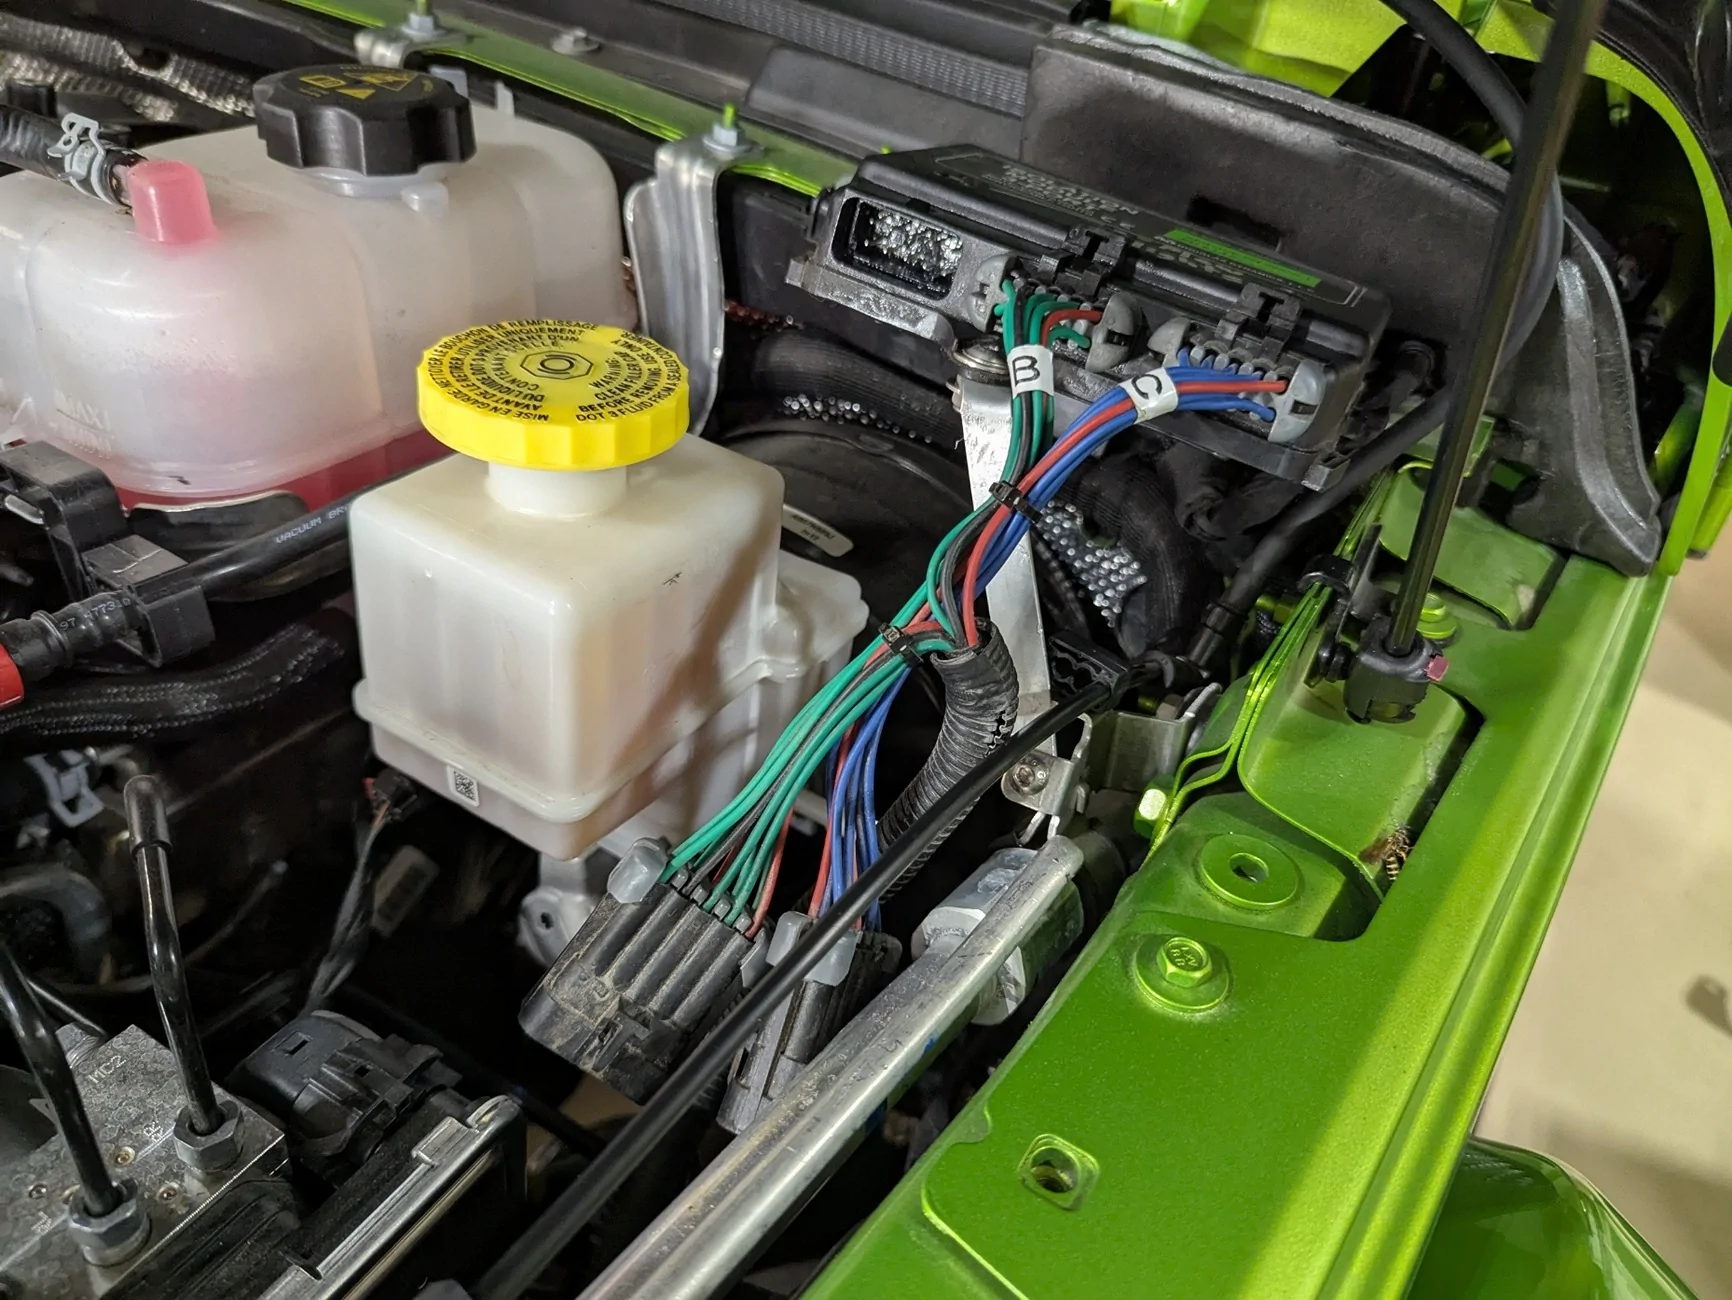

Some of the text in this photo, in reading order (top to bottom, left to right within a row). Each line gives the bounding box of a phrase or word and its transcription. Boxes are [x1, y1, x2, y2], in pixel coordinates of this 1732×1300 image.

[497, 327, 586, 339] UNIQUEMENT
[547, 334, 580, 342] D'UN
[611, 339, 642, 352] ONLY
[637, 353, 658, 364] USE
[428, 319, 600, 421] MISE EN GARDE: NETTOYER LE BOUCHON DE REMPLISSAGE
[589, 357, 621, 388] WARNING:
[594, 350, 643, 400] CLEAN FILLER CAP
[1012, 355, 1040, 387] B
[460, 382, 481, 392] LE
[473, 389, 496, 400] DE
[475, 375, 523, 398] LIQUIDE
[576, 412, 605, 421] DOT
[618, 401, 654, 416] FLUID
[648, 386, 674, 403] FROM
[663, 359, 682, 381] SEALED
[1131, 374, 1162, 399] C
[489, 397, 542, 411] AVANT
[521, 393, 545, 402] DU
[578, 396, 634, 412] BEFORE
[276, 517, 322, 543] VACUUM
[88, 1055, 126, 1083] MC2
